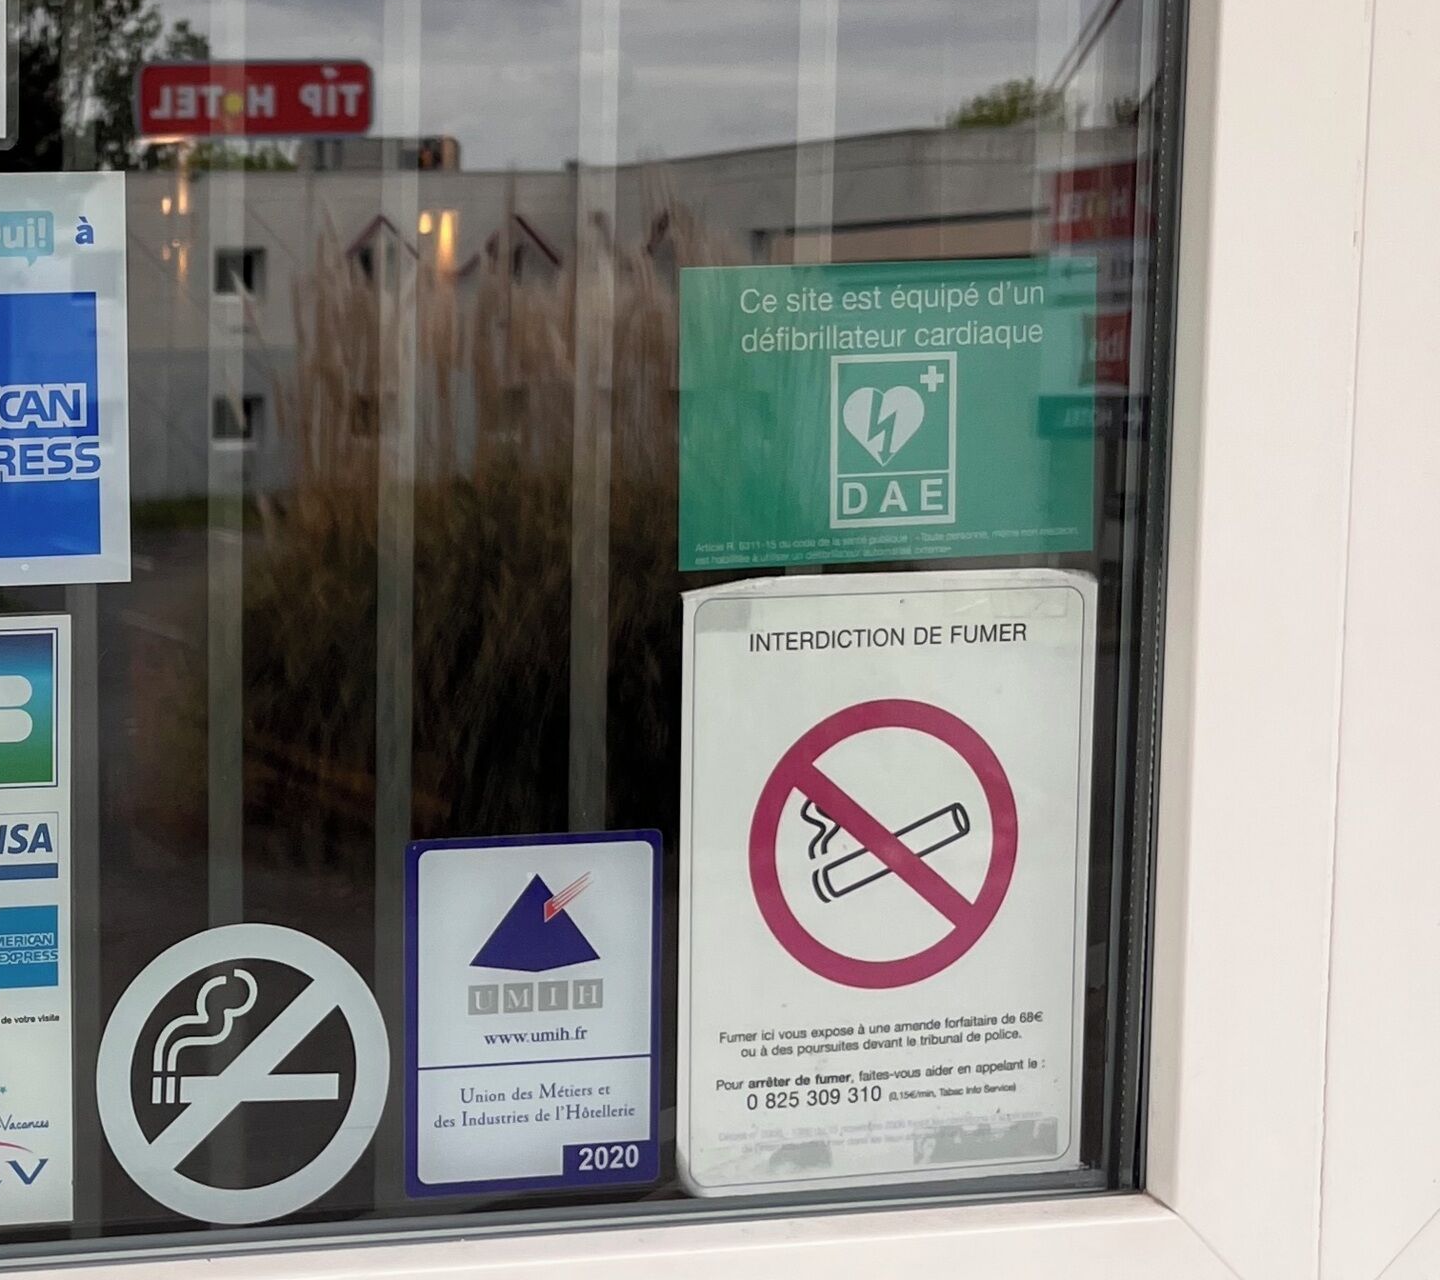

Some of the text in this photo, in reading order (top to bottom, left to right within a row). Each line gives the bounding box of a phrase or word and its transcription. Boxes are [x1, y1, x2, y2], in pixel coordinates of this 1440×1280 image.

[75, 216, 94, 245] à
[741, 281, 1043, 313] Ce site est équipé d'un
[742, 321, 1043, 352] défibrillateur cardiaque
[750, 623, 1026, 652] INTERDICTION DE FUMER
[472, 982, 600, 1013] UMIH
[484, 1026, 587, 1044] www.umih.fr
[720, 1011, 1043, 1043] Fumer vous expose amende forfaitaire 68€
[797, 1029, 1021, 1056] poursuites devant tribunal police.
[716, 1060, 1023, 1090] Pour arrêter fumer, faites-vous aider appelant
[461, 1083, 592, 1103] Union des Métiers
[746, 1086, 882, 1110] 0 825 309 310
[434, 1104, 635, 1128] des Industries l'Hôtellerie
[578, 1144, 639, 1170] 2020
